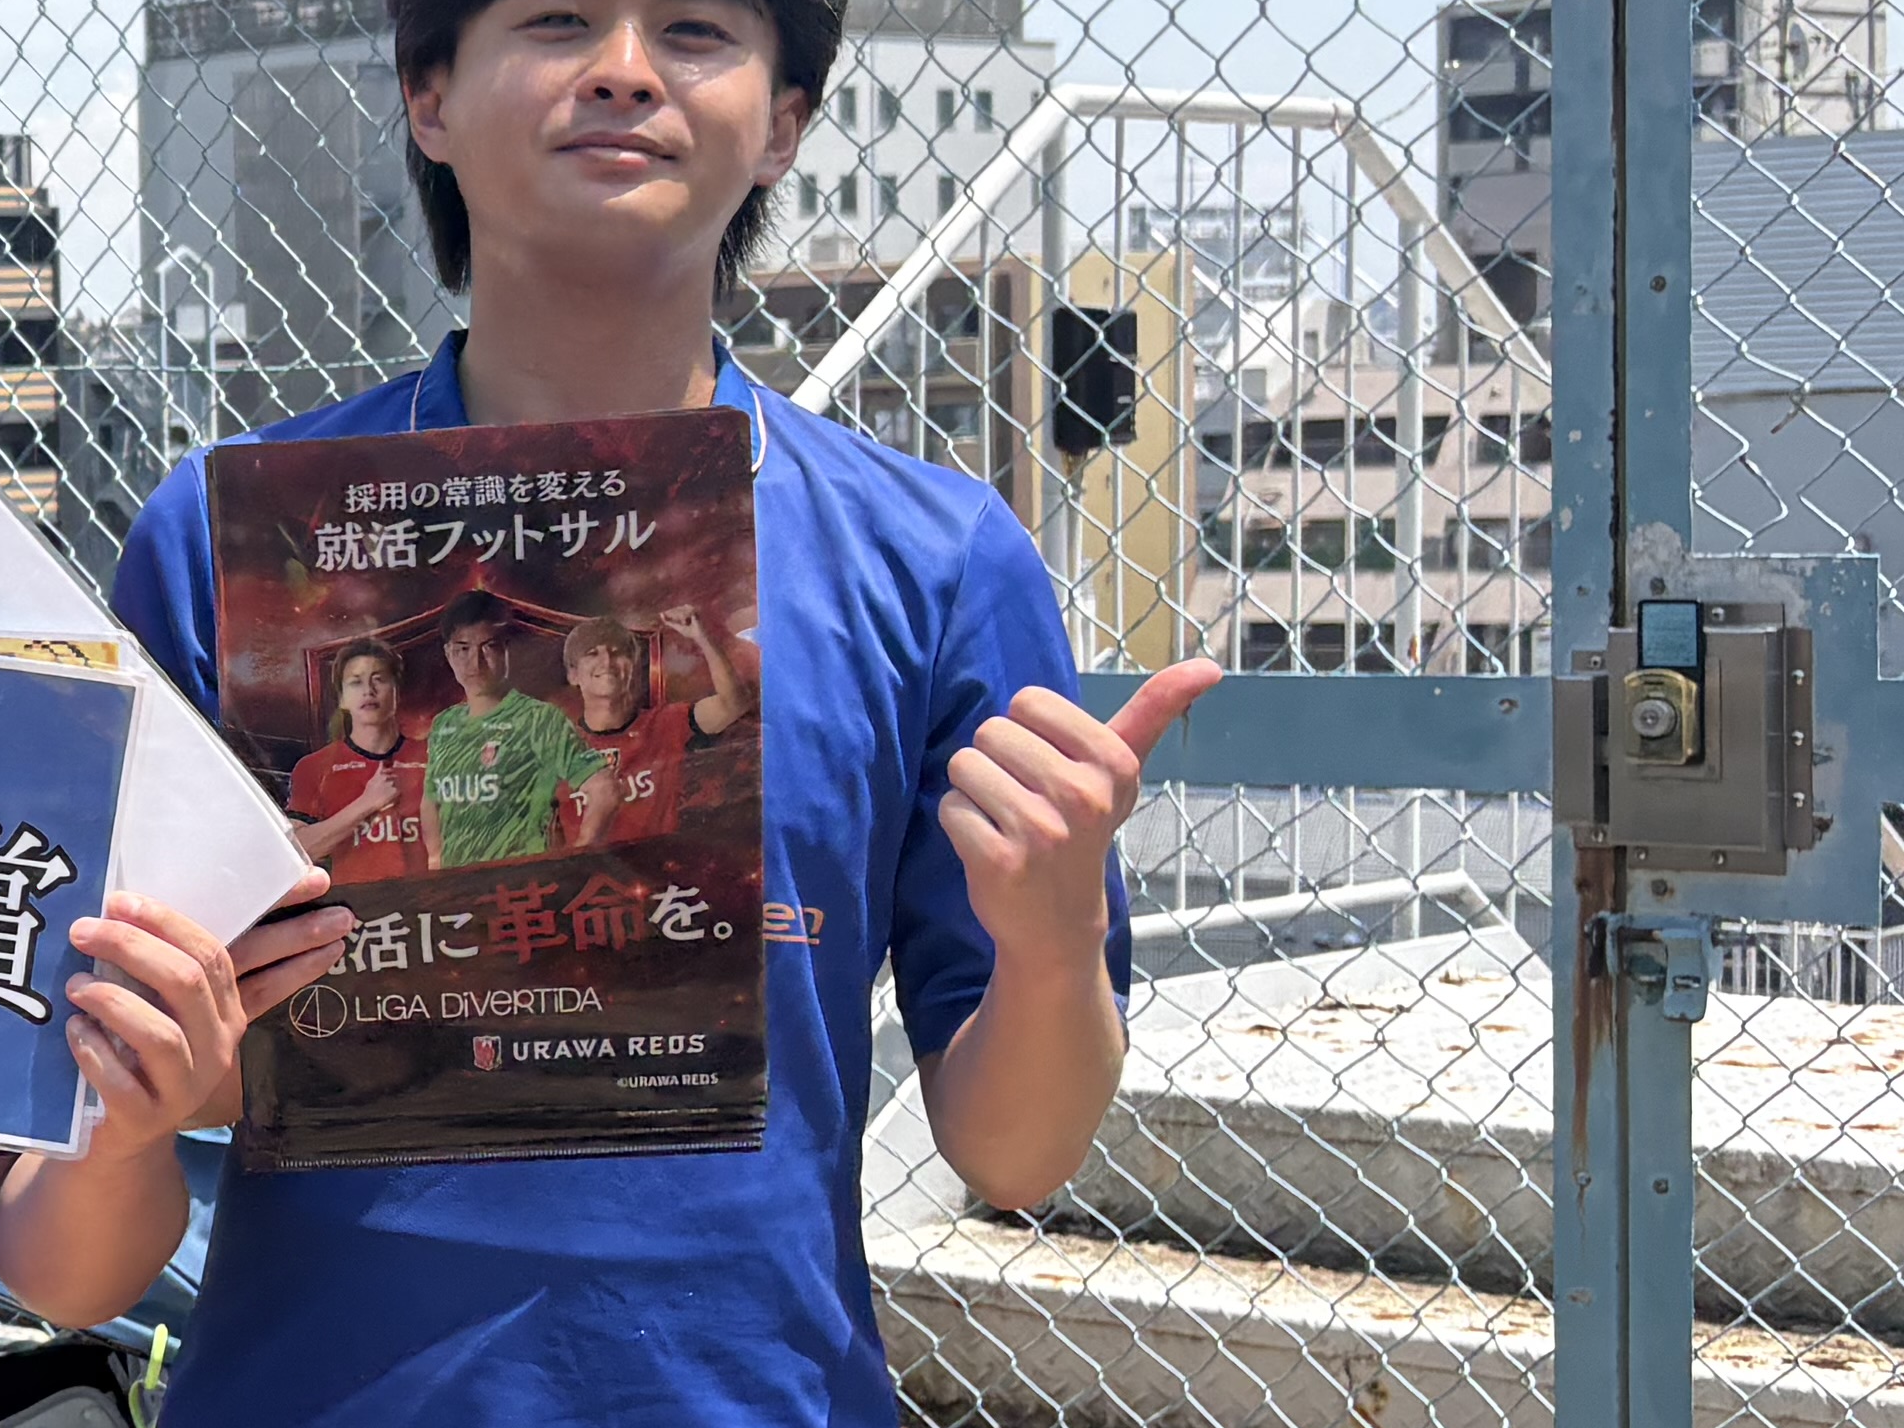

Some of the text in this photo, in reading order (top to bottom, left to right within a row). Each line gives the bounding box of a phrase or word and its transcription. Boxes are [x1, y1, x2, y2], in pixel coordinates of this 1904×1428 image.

[344, 469, 627, 514] 採用の常識を変える
[315, 509, 657, 572] 就活フットサル
[330, 874, 734, 974] 活に革命を。
[512, 1033, 707, 1062] URAWA REDS
